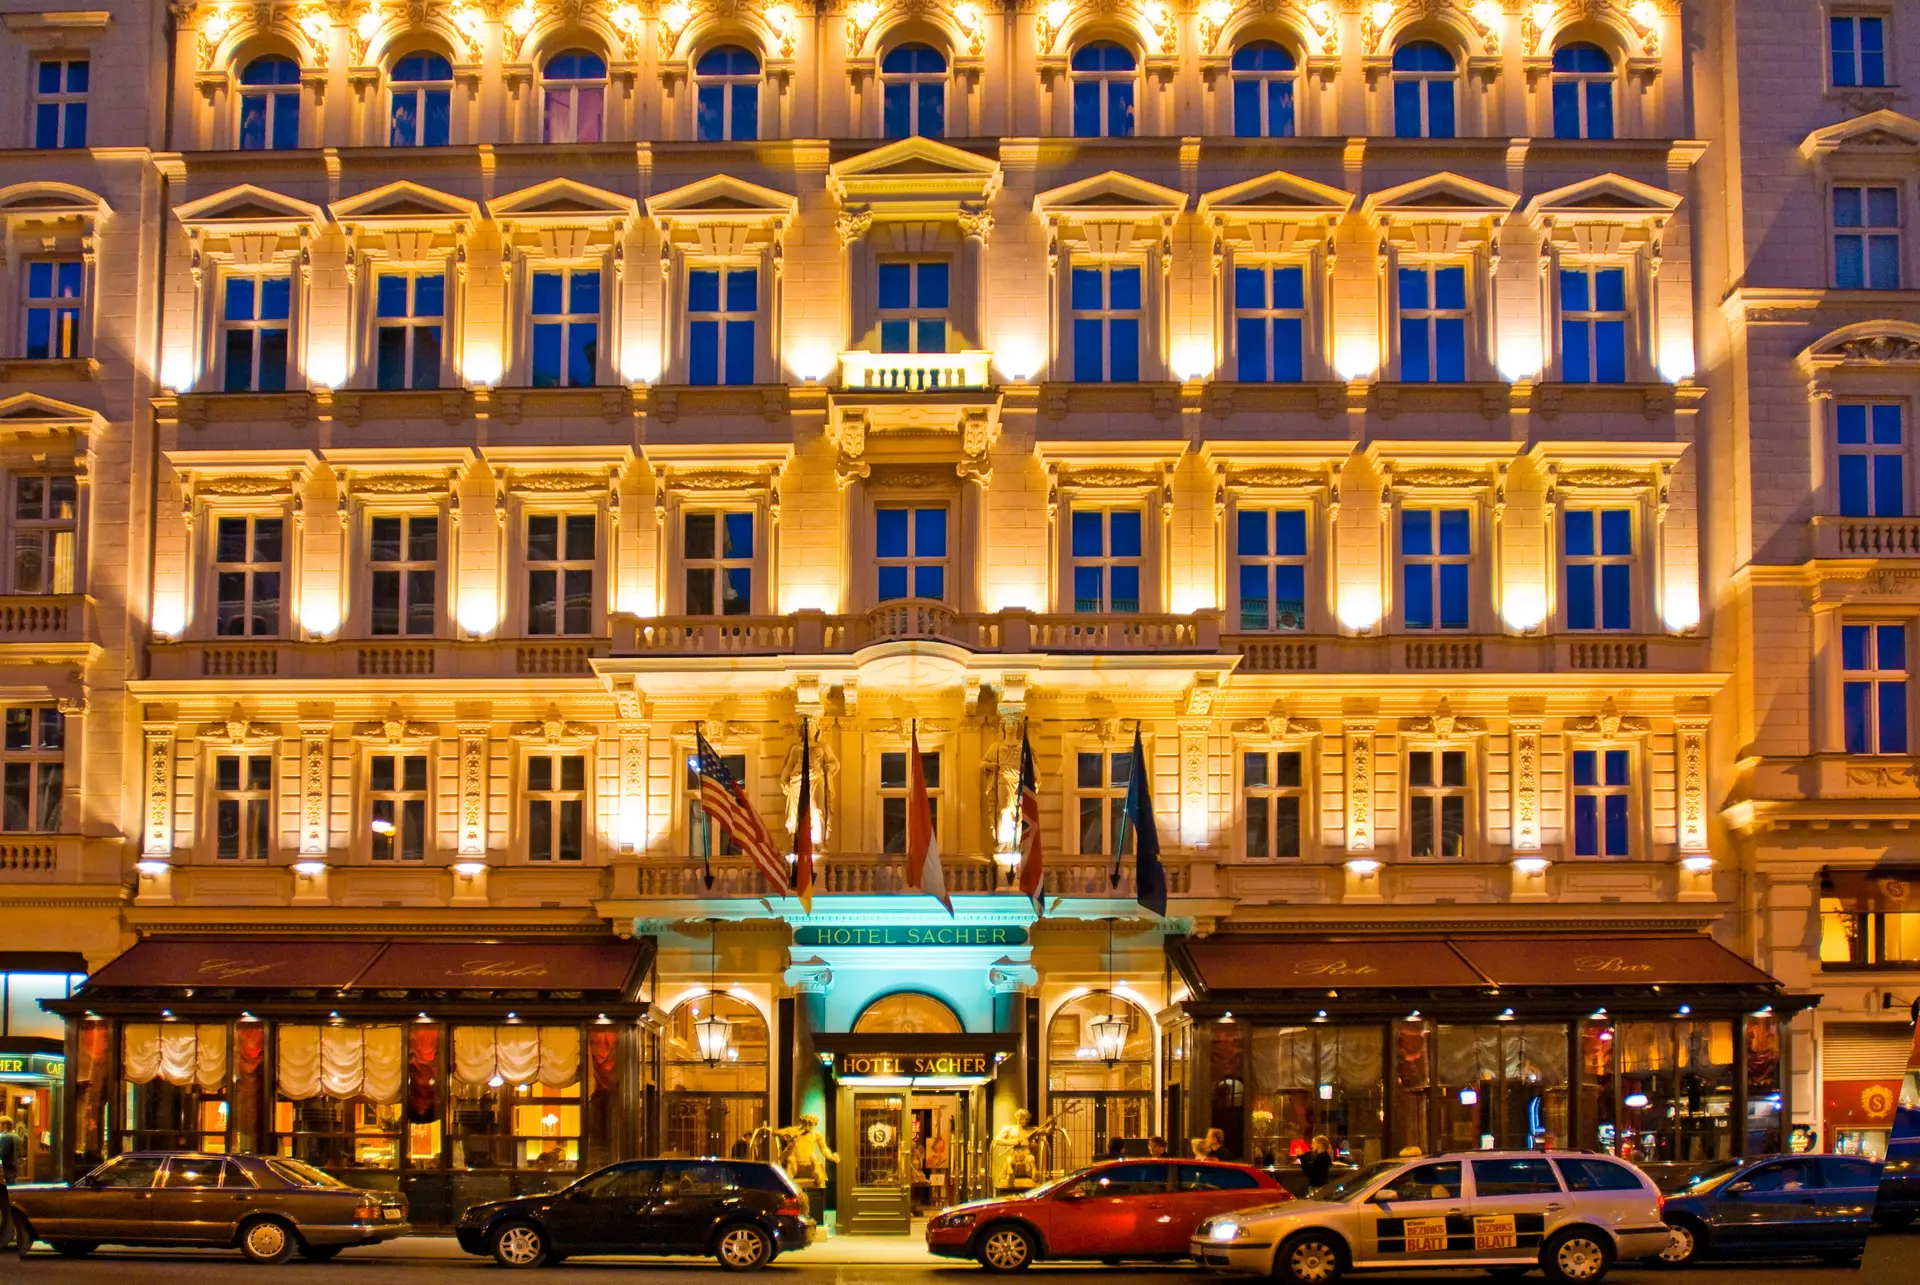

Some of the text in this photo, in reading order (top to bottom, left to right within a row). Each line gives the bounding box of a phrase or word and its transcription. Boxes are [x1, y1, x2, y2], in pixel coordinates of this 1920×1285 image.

[817, 928, 1007, 944] HOTEL SACHER
[1574, 956, 1654, 972] Bar
[843, 1057, 986, 1073] HOTEL SACHER
[1872, 1096, 1883, 1110] S
[1407, 1237, 1444, 1251] BLATT
[1476, 1235, 1513, 1249] BLATT
